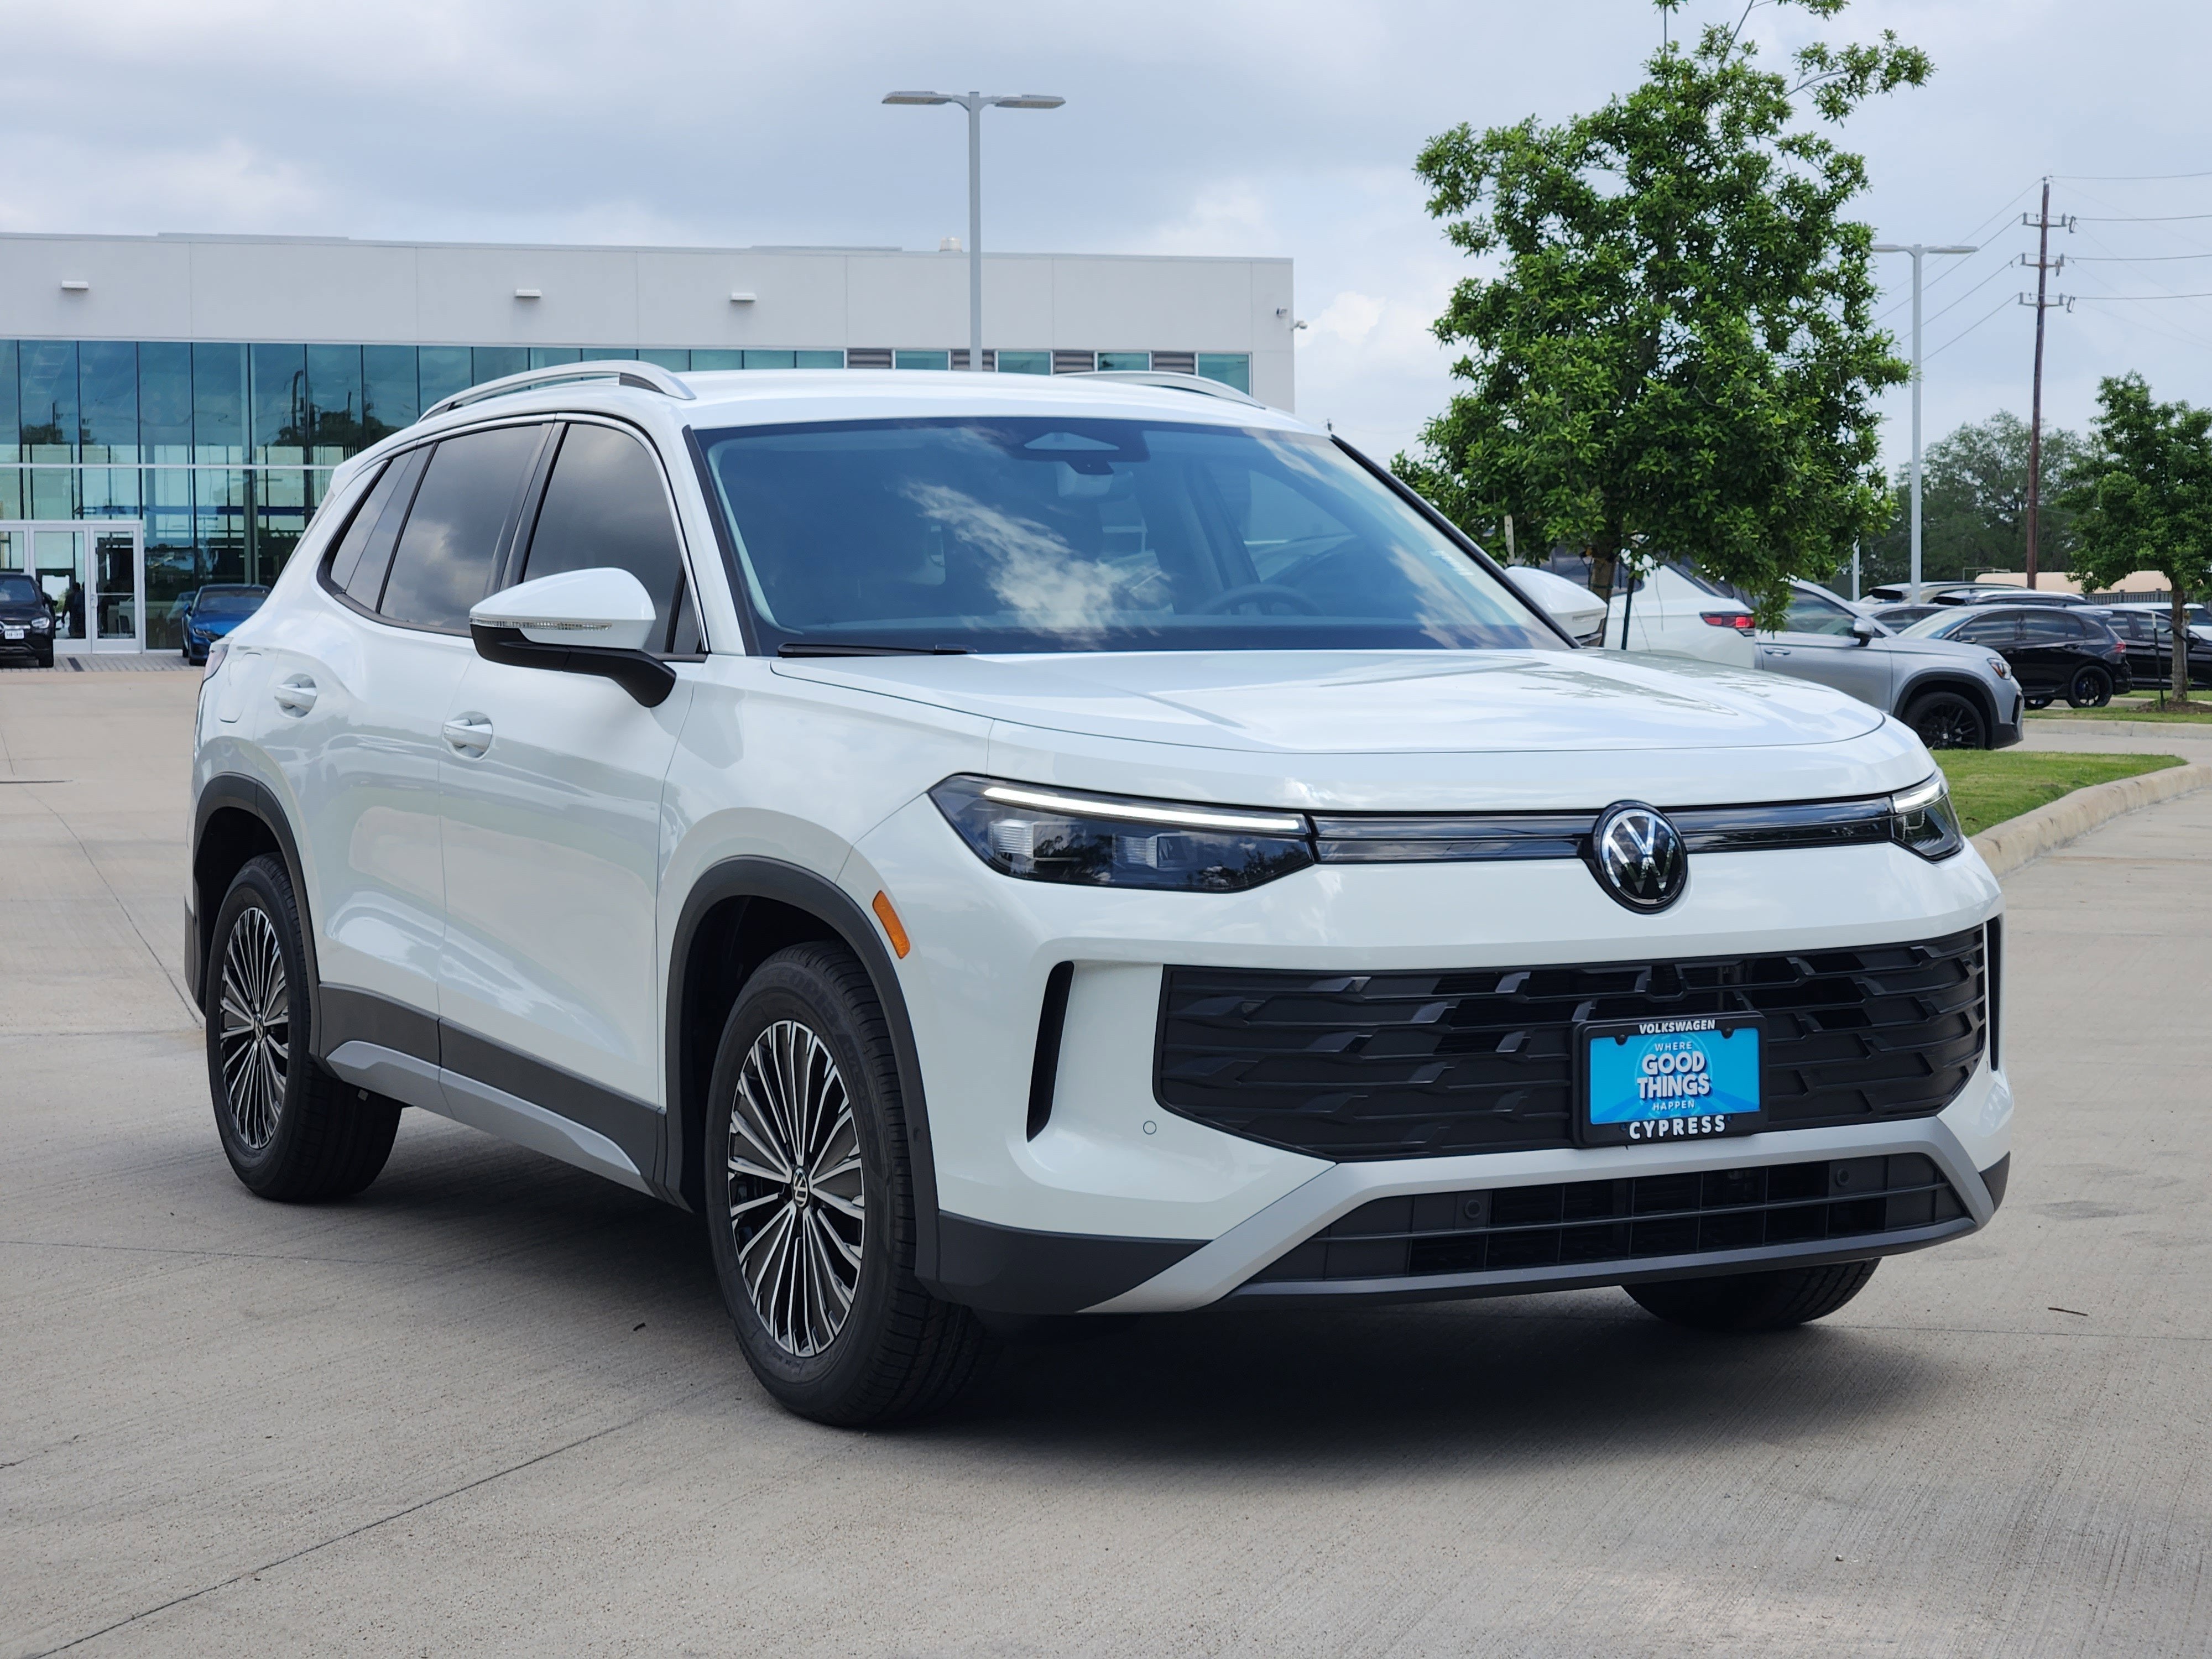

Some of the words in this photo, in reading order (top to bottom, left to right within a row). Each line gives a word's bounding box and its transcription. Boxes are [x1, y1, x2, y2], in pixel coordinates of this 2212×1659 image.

[1639, 1020, 1715, 1034] VOLKSWAGEN
[1655, 1042, 1692, 1051] WHERE
[1642, 1051, 1705, 1075] GOOD
[1637, 1073, 1710, 1098] THINGS
[1653, 1100, 1695, 1111] HAPPEN
[1629, 1115, 1725, 1139] CYPRESS
